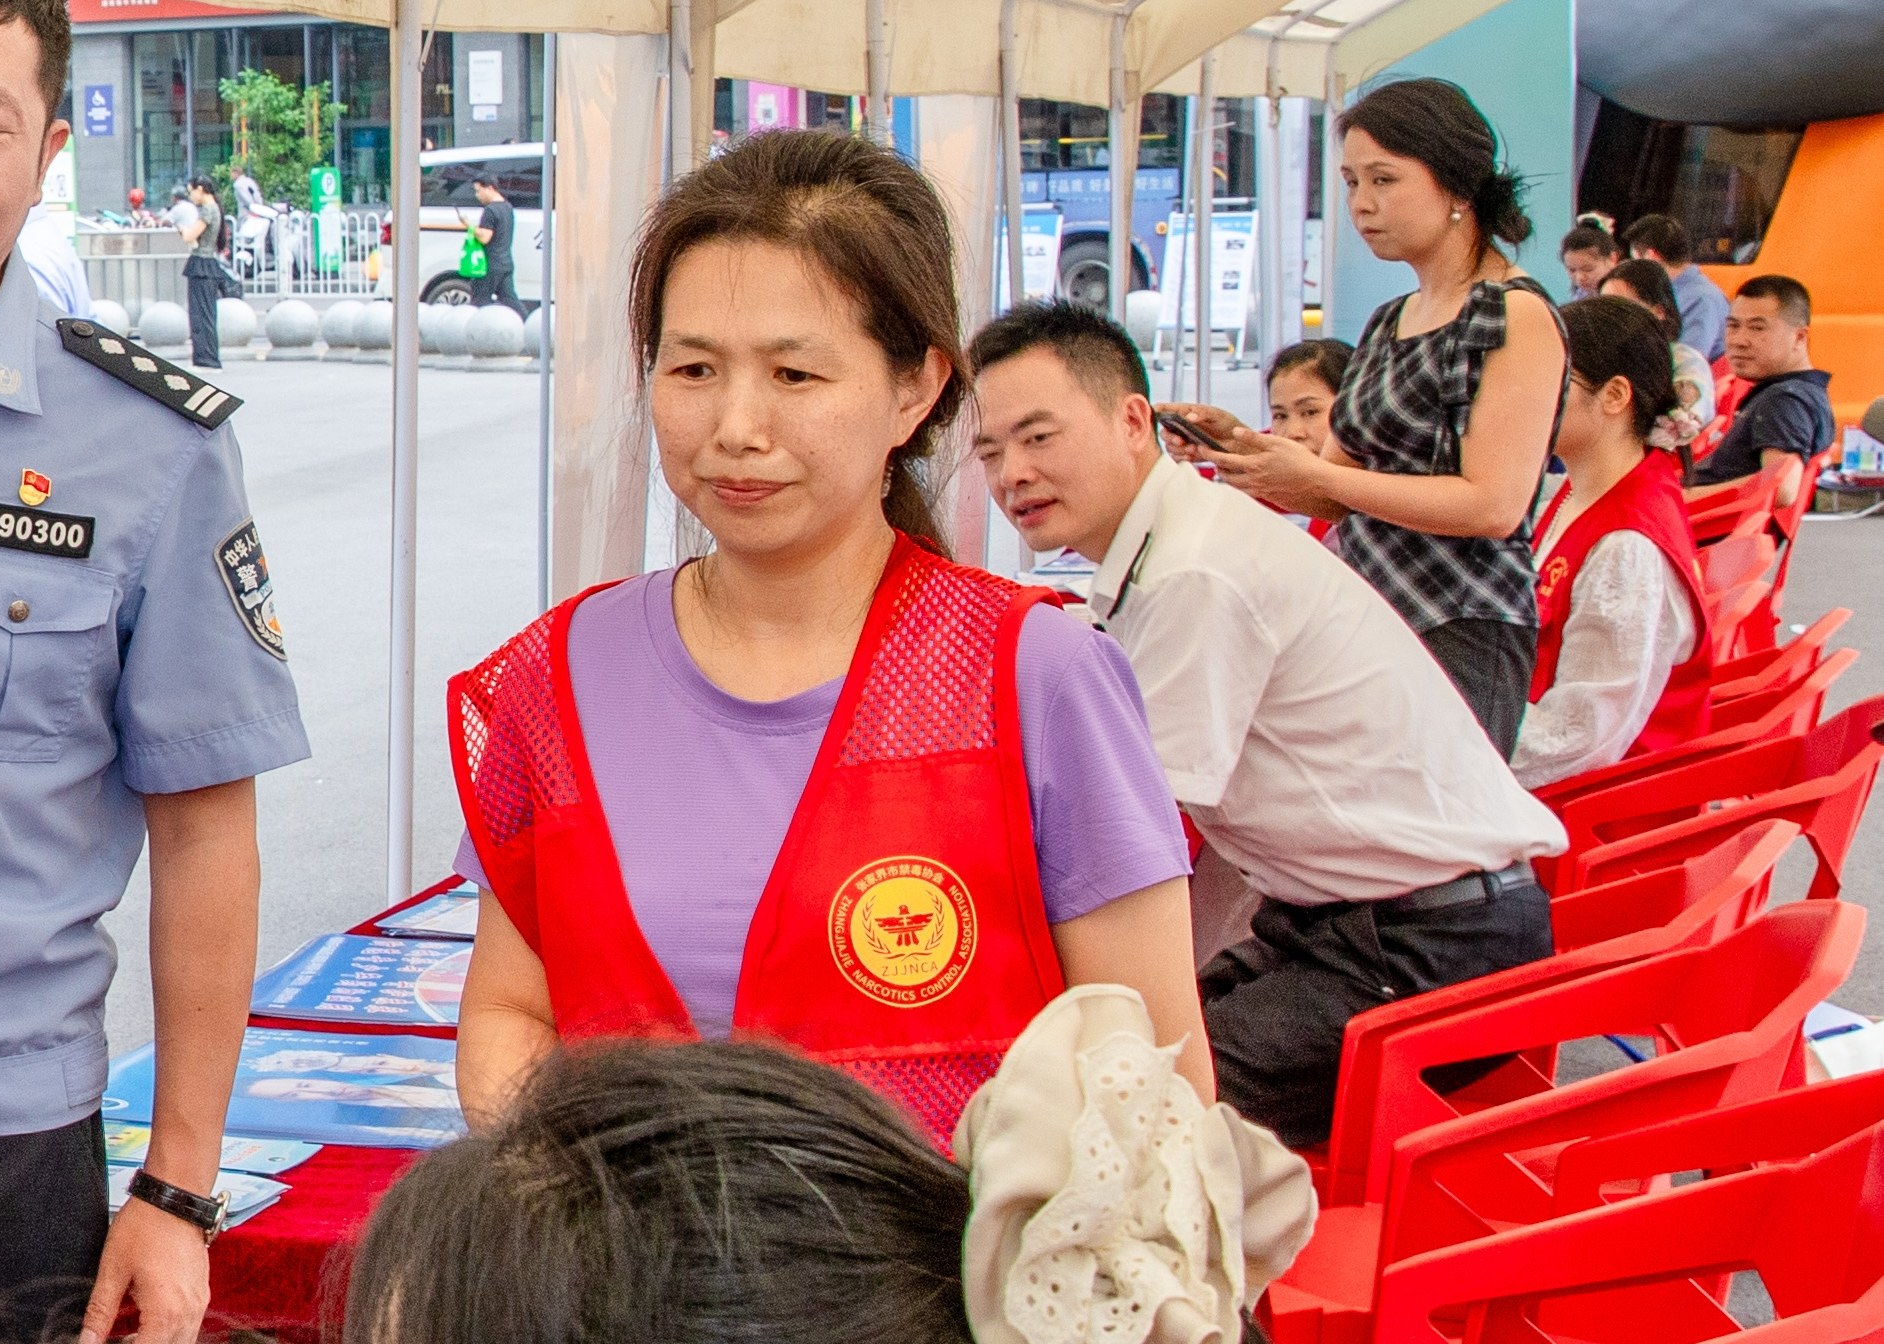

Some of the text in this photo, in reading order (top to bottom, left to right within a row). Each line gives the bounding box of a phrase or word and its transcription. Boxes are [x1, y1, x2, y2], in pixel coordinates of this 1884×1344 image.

[833, 884, 973, 1001] ZHANGJIAJIE NARCOTICS CONTROL ASSOCIATION
[881, 960, 939, 977] ZJJNCA
